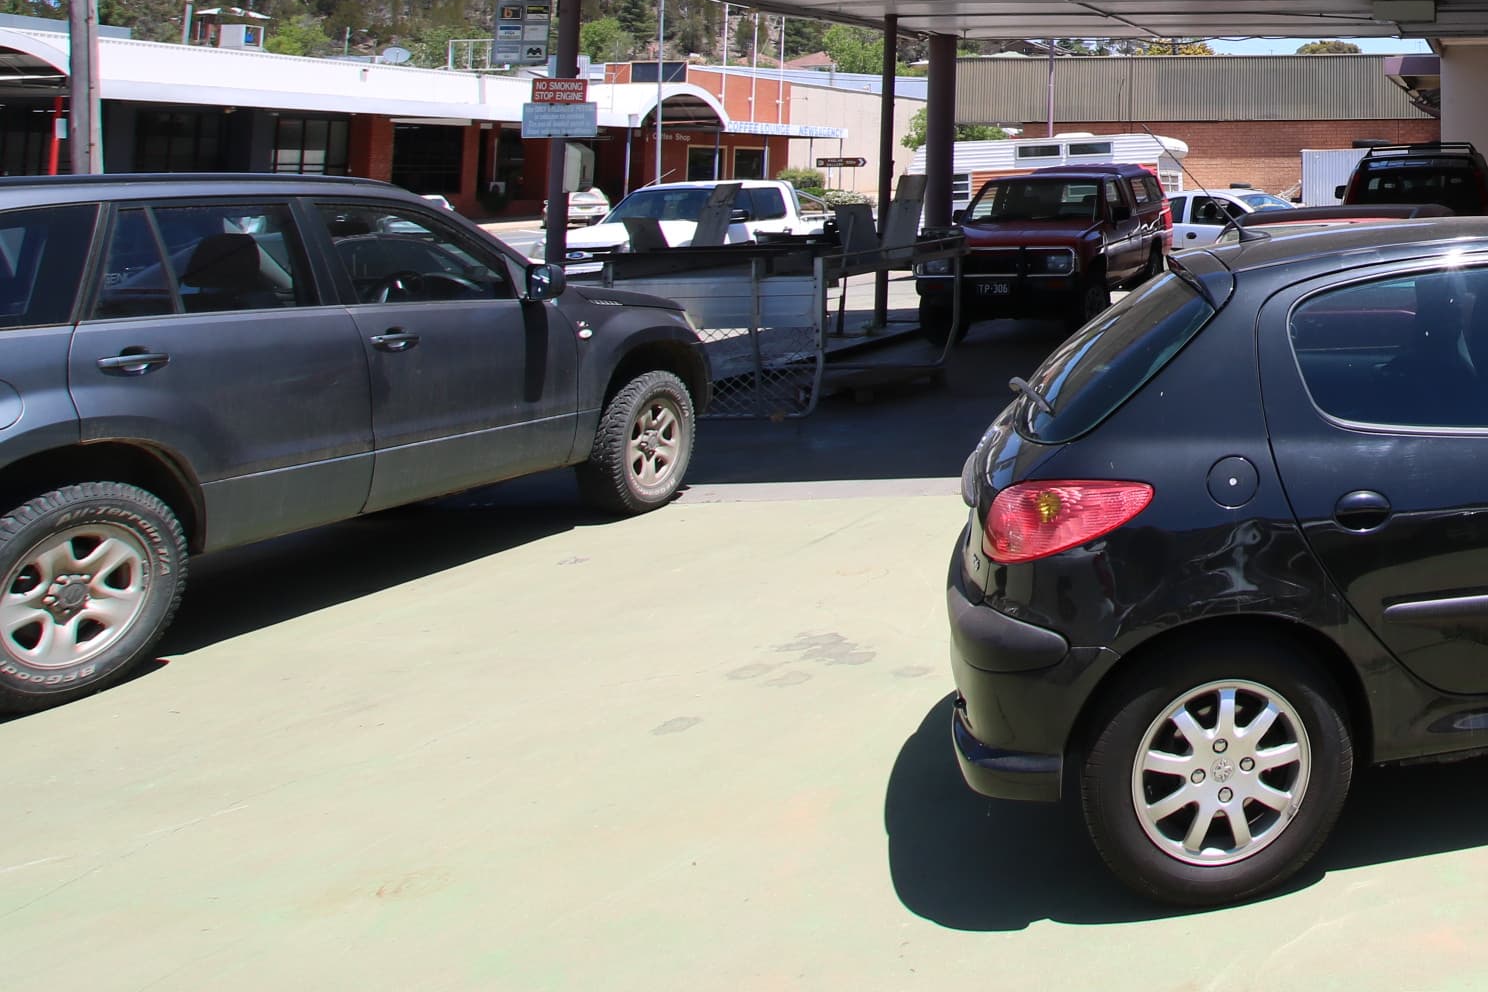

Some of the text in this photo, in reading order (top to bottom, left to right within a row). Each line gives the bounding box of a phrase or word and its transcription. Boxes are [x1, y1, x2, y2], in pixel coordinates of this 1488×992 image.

[535, 81, 583, 91] NO SMOKING
[535, 91, 584, 101] STOP ENGINE
[728, 121, 759, 133] COFFEE
[675, 133, 691, 142] Shop
[56, 506, 170, 577] All-Terrain T/A
